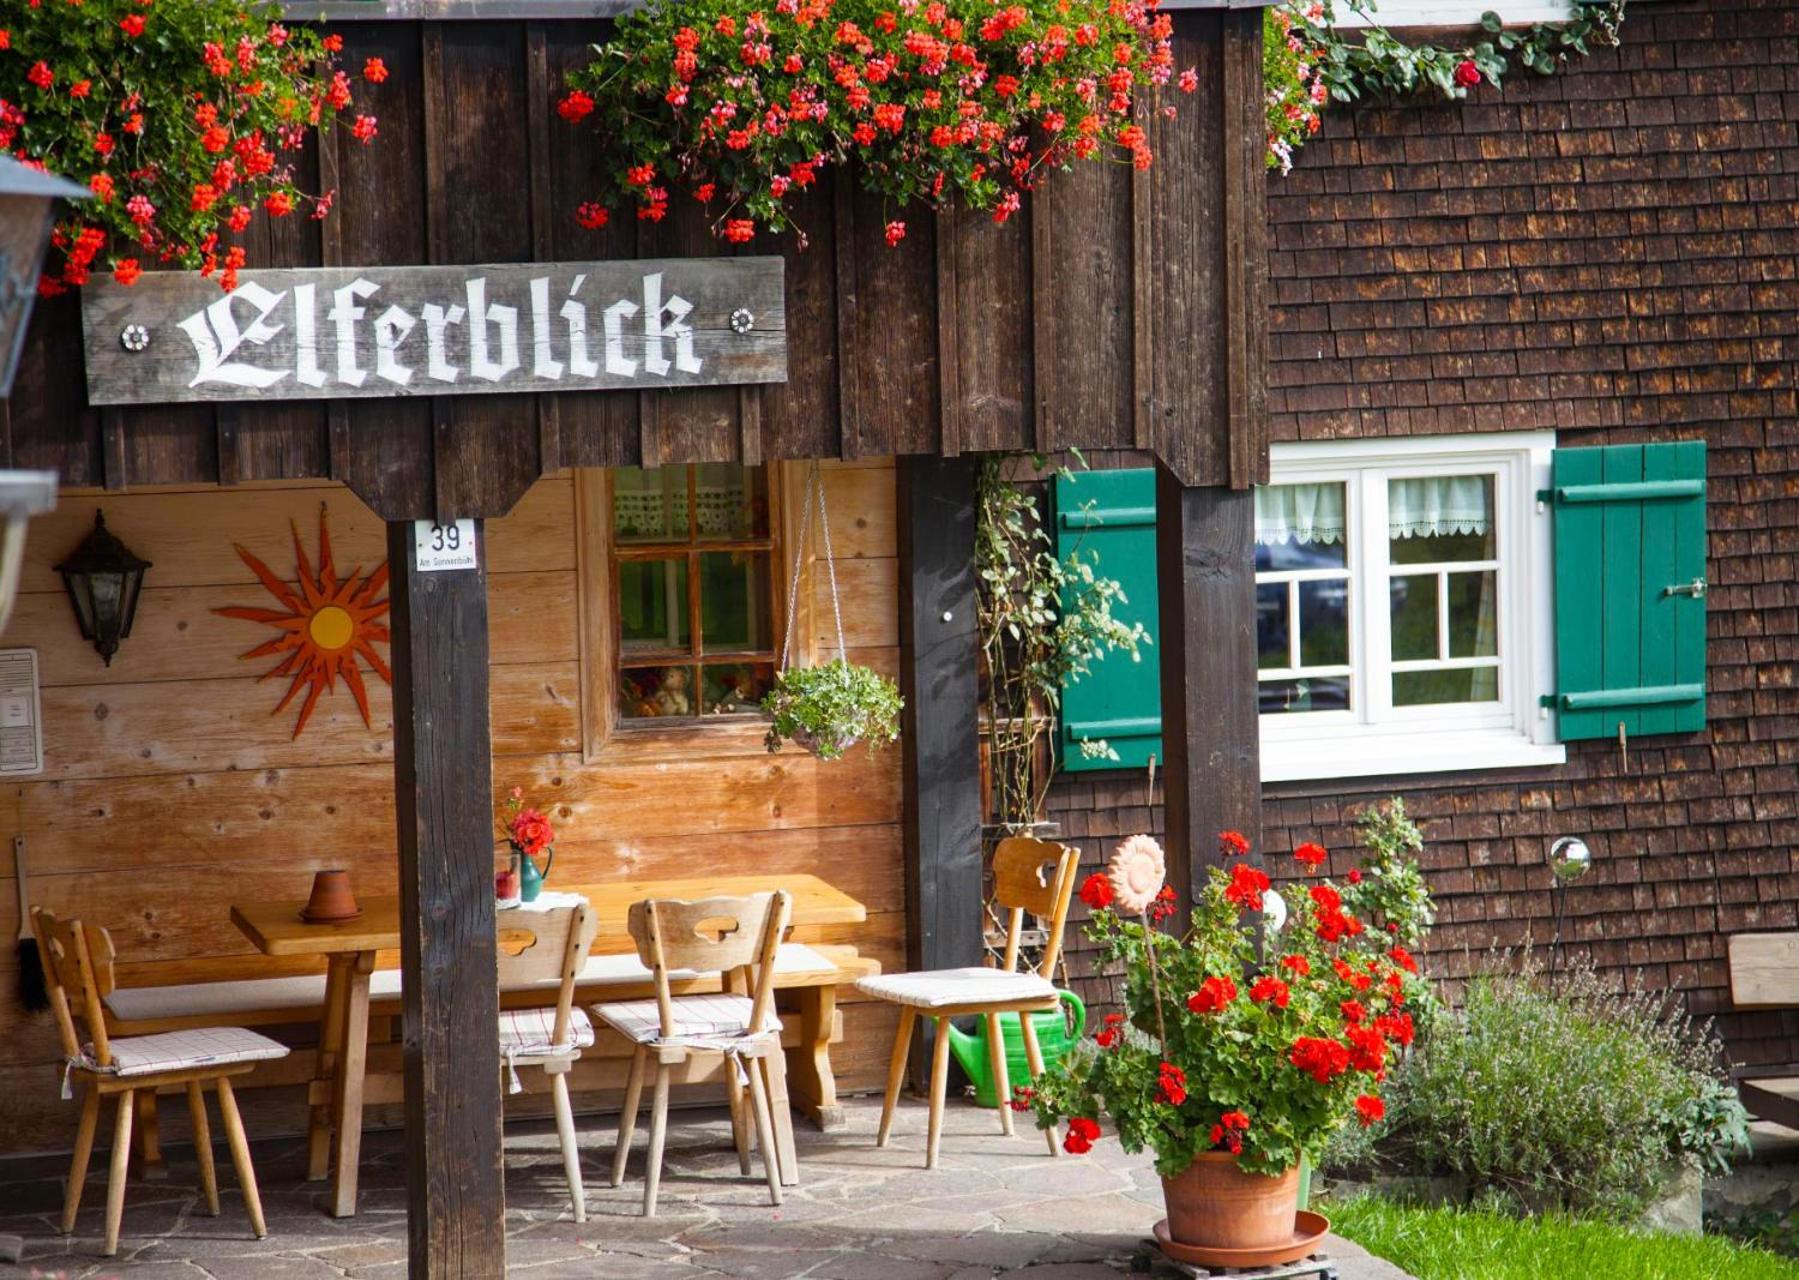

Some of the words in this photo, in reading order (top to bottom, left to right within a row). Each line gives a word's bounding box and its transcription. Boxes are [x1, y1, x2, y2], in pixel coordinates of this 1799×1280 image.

[176, 273, 703, 389] Elferblick
[431, 525, 460, 551] 39
[419, 558, 431, 567] Am
